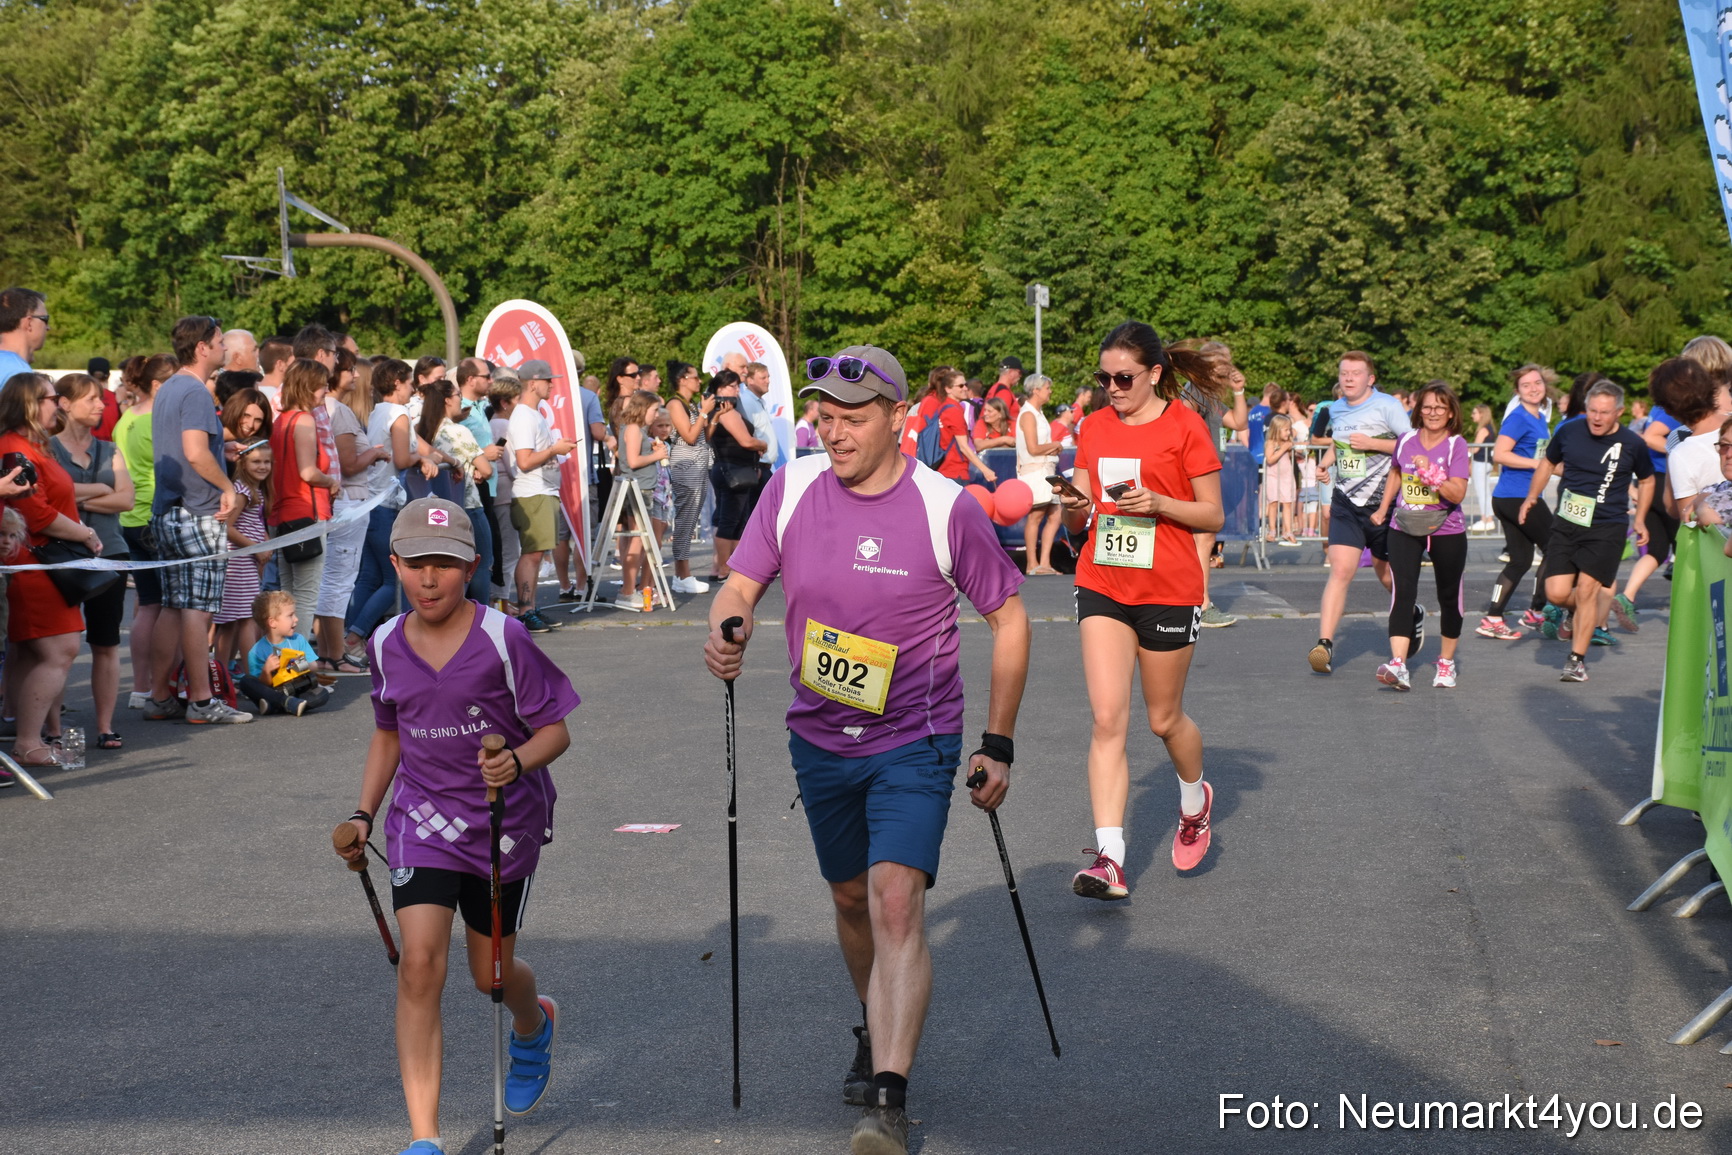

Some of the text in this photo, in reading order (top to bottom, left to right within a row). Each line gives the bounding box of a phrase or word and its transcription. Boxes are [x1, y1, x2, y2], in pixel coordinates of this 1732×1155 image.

[1339, 459, 1360, 470] 1947
[1407, 484, 1429, 497] 906
[1564, 501, 1588, 518] 1938
[1105, 533, 1138, 553] 519
[853, 563, 909, 577] Fertigteilwerke
[1156, 624, 1186, 633] hummel
[817, 652, 868, 689] 902
[838, 684, 861, 696] Tobias
[410, 719, 492, 739] WIR SIND LILA.
